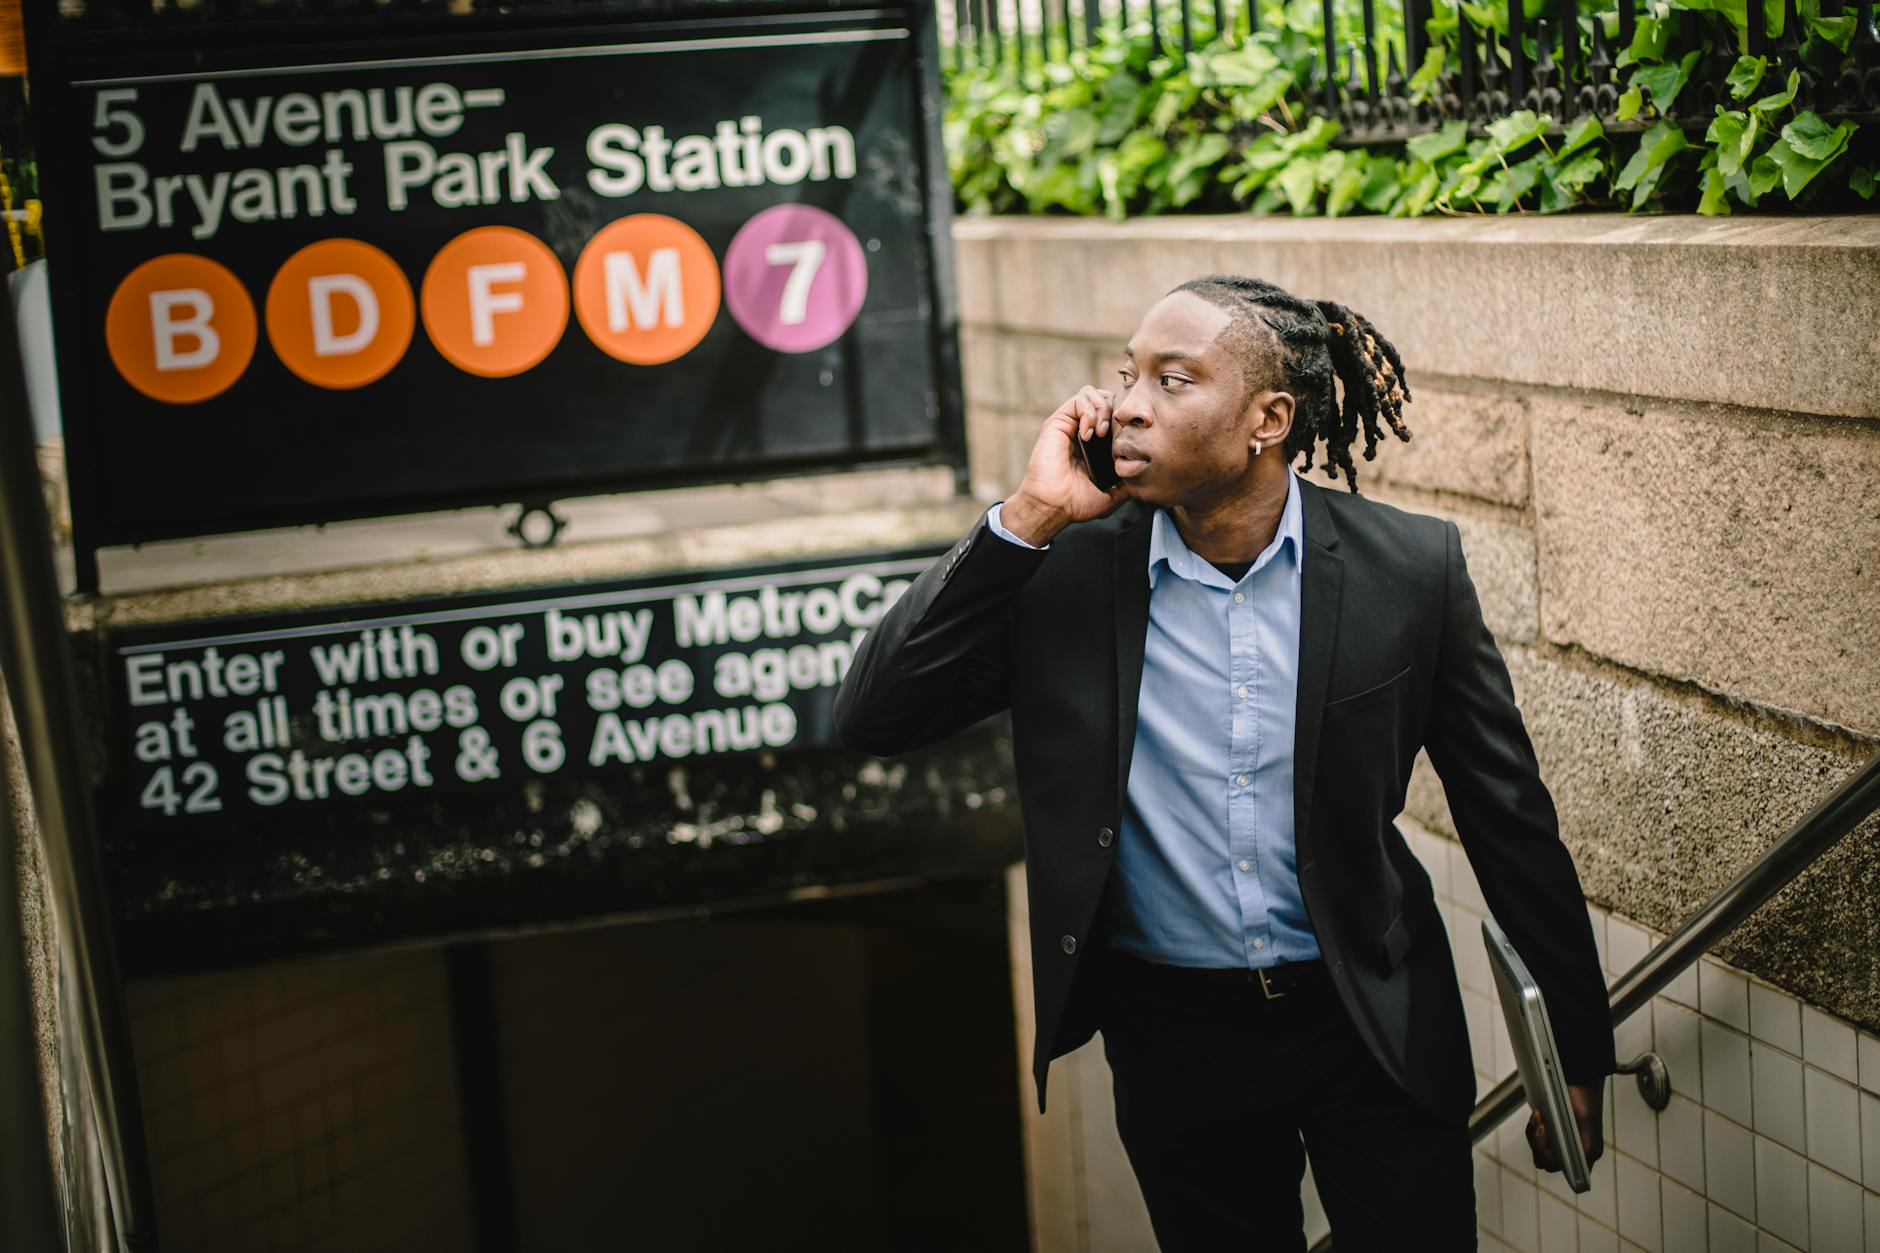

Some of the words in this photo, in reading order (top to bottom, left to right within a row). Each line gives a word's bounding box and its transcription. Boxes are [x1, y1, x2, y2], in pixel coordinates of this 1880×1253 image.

[91, 87, 145, 157] 5
[94, 149, 357, 240] Bryant
[384, 132, 561, 211] Park
[586, 115, 857, 197] Station
[149, 288, 220, 371] B
[308, 273, 380, 357] D
[467, 262, 526, 347] F
[604, 247, 685, 332] M
[765, 239, 826, 325] 7
[125, 646, 285, 706] Enter
[310, 625, 440, 686] with
[461, 622, 525, 671] or
[545, 607, 654, 664] buy
[135, 707, 197, 762] at
[223, 695, 290, 753] all
[312, 685, 479, 742] times
[500, 673, 564, 722] or
[586, 659, 695, 712] see
[140, 761, 223, 817] 42
[246, 735, 434, 805] Street
[455, 726, 501, 783] &
[521, 719, 566, 773] 6
[588, 702, 798, 767] Avenue
